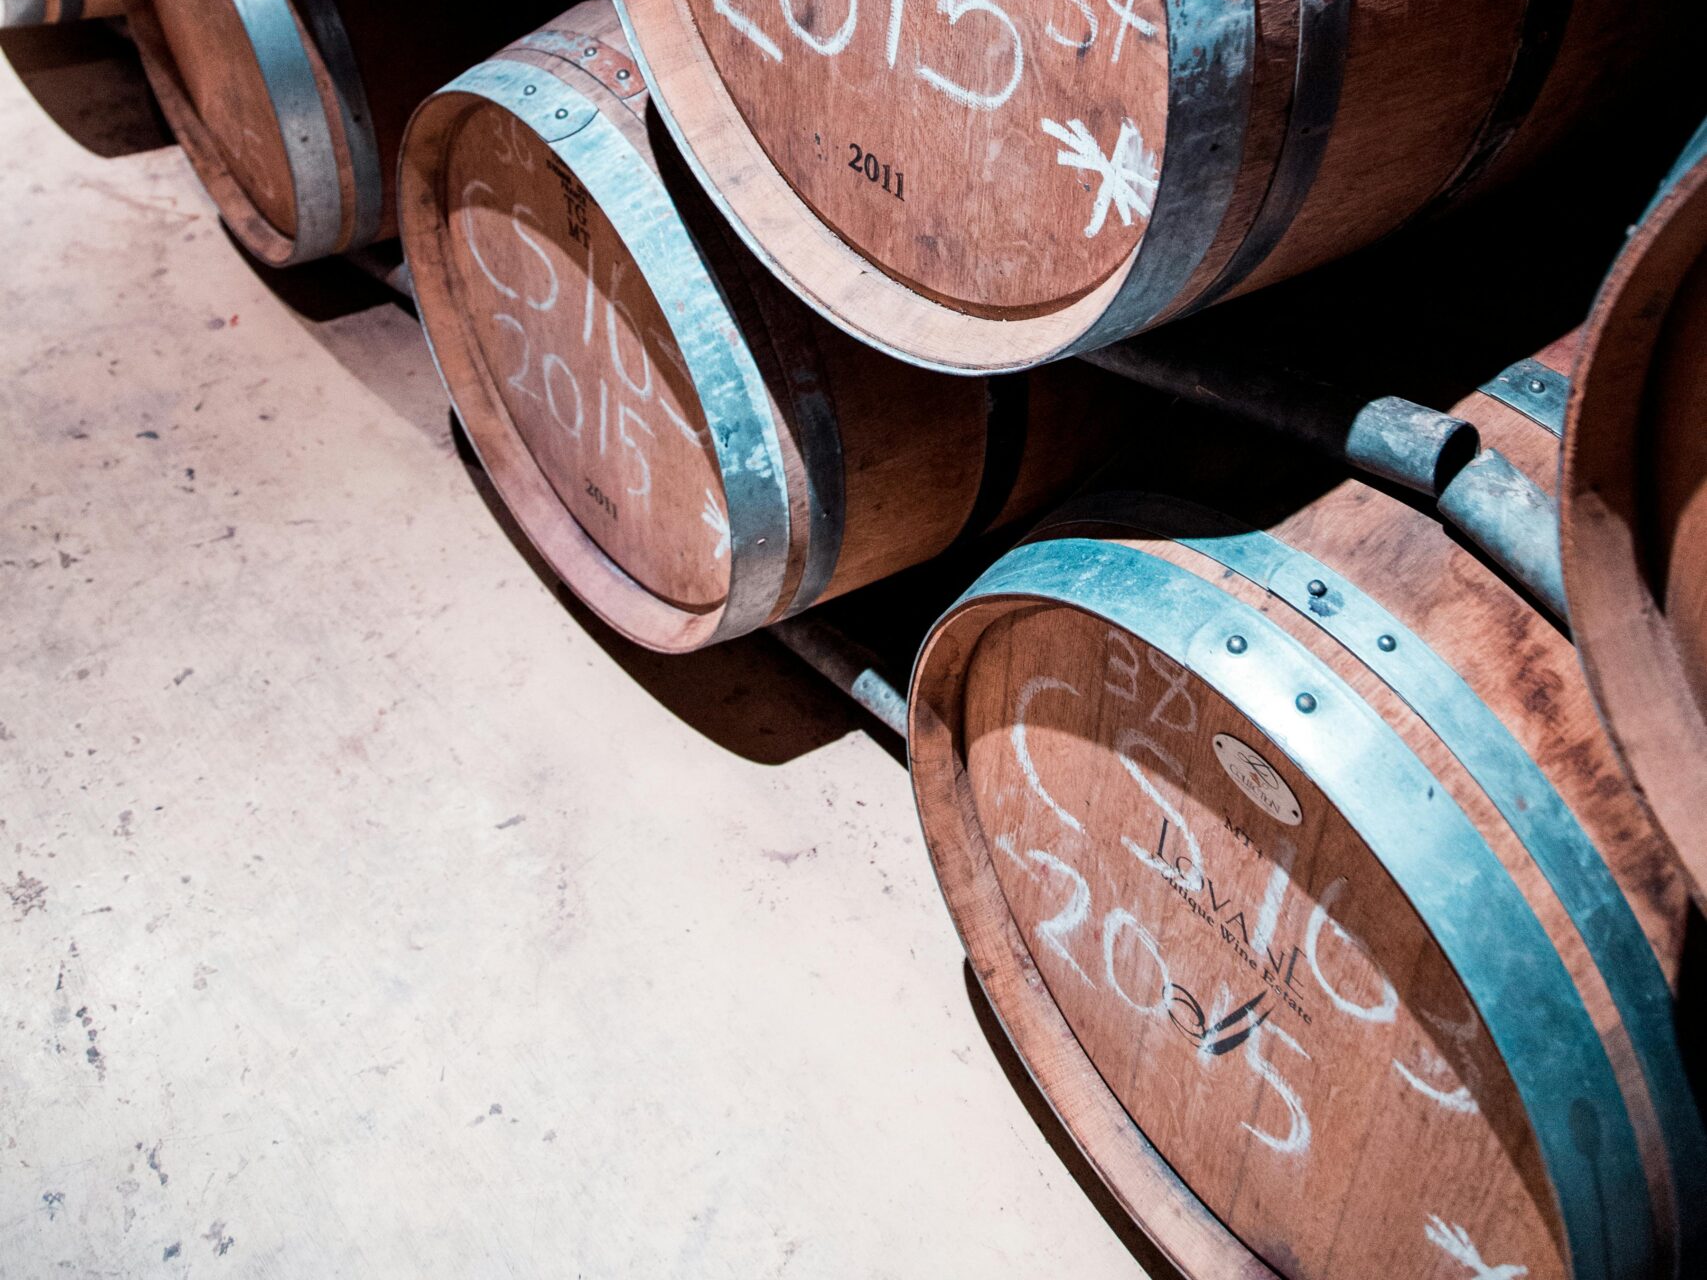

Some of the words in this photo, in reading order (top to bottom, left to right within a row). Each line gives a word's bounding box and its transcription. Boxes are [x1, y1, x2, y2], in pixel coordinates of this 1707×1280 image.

[847, 142, 905, 202] 2011
[493, 312, 654, 495] 2015
[584, 477, 618, 521] 2011
[1156, 866, 1215, 928] outique
[1220, 922, 1259, 969] Wine
[1263, 968, 1313, 1024] Estate
